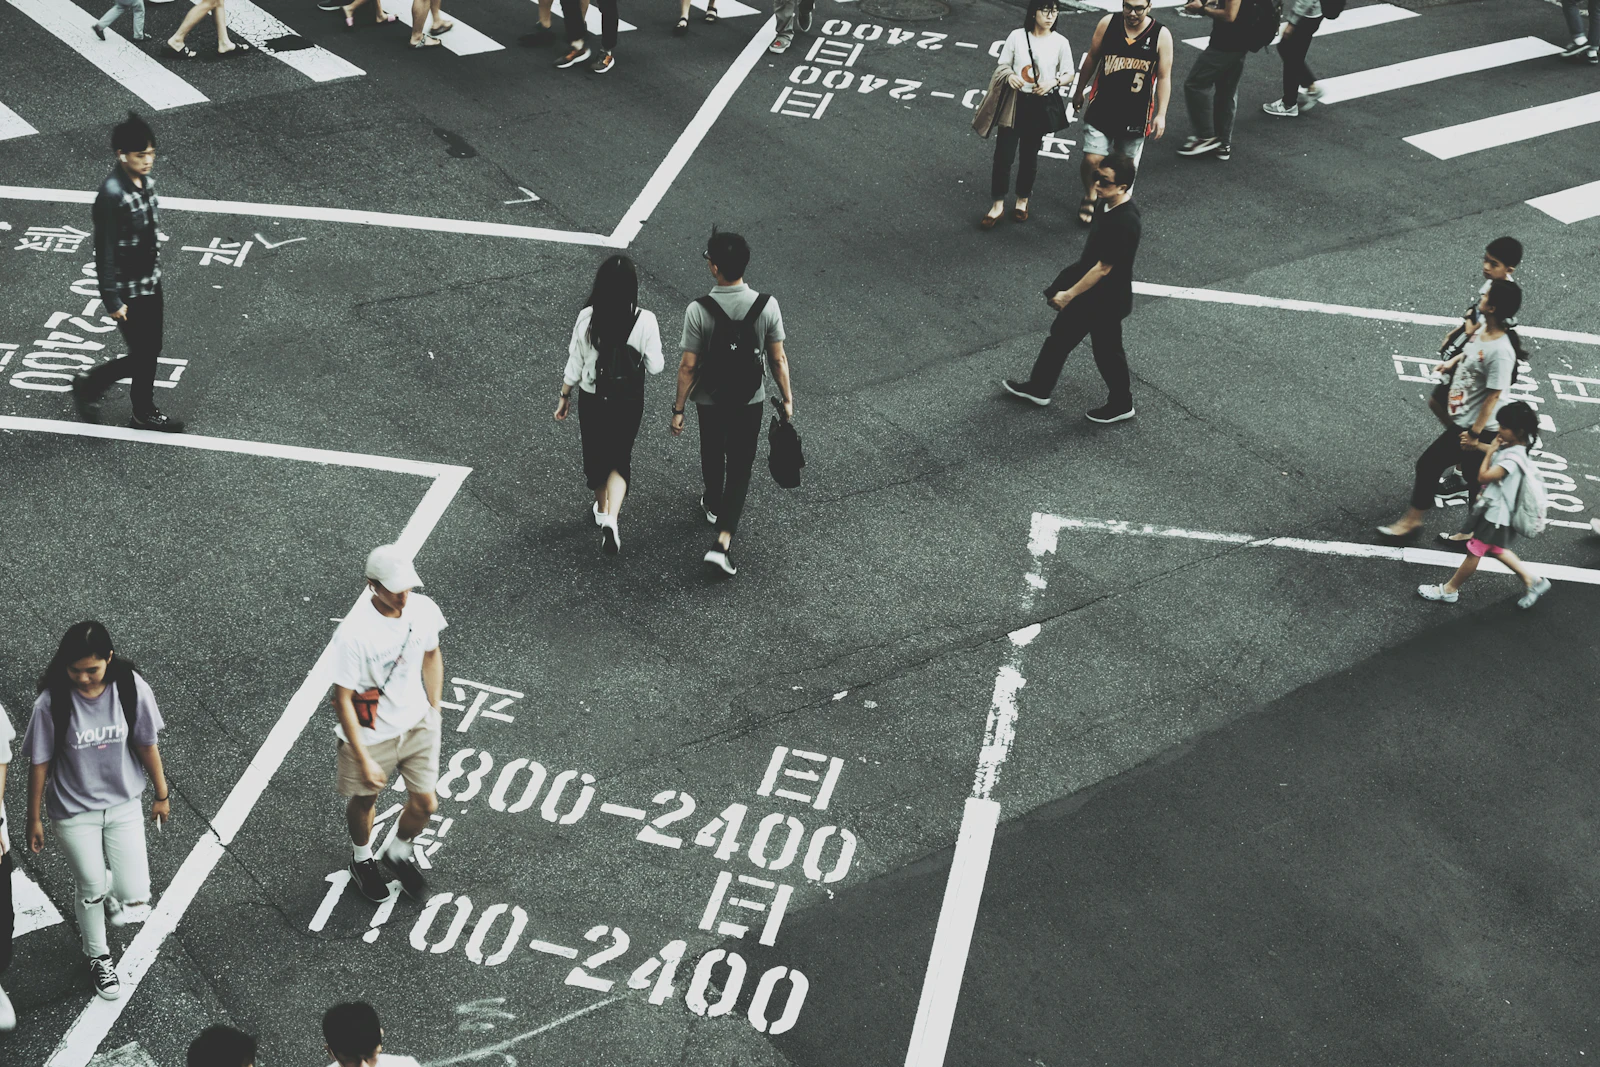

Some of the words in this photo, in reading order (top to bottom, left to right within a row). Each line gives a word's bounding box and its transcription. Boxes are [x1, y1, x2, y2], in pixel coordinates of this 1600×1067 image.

[1104, 54, 1151, 76] WARRIORS
[1130, 72, 1146, 93] 5
[75, 722, 125, 745] YOUTH
[391, 747, 858, 884] 800-2400
[308, 868, 810, 1035] 1100-2400
